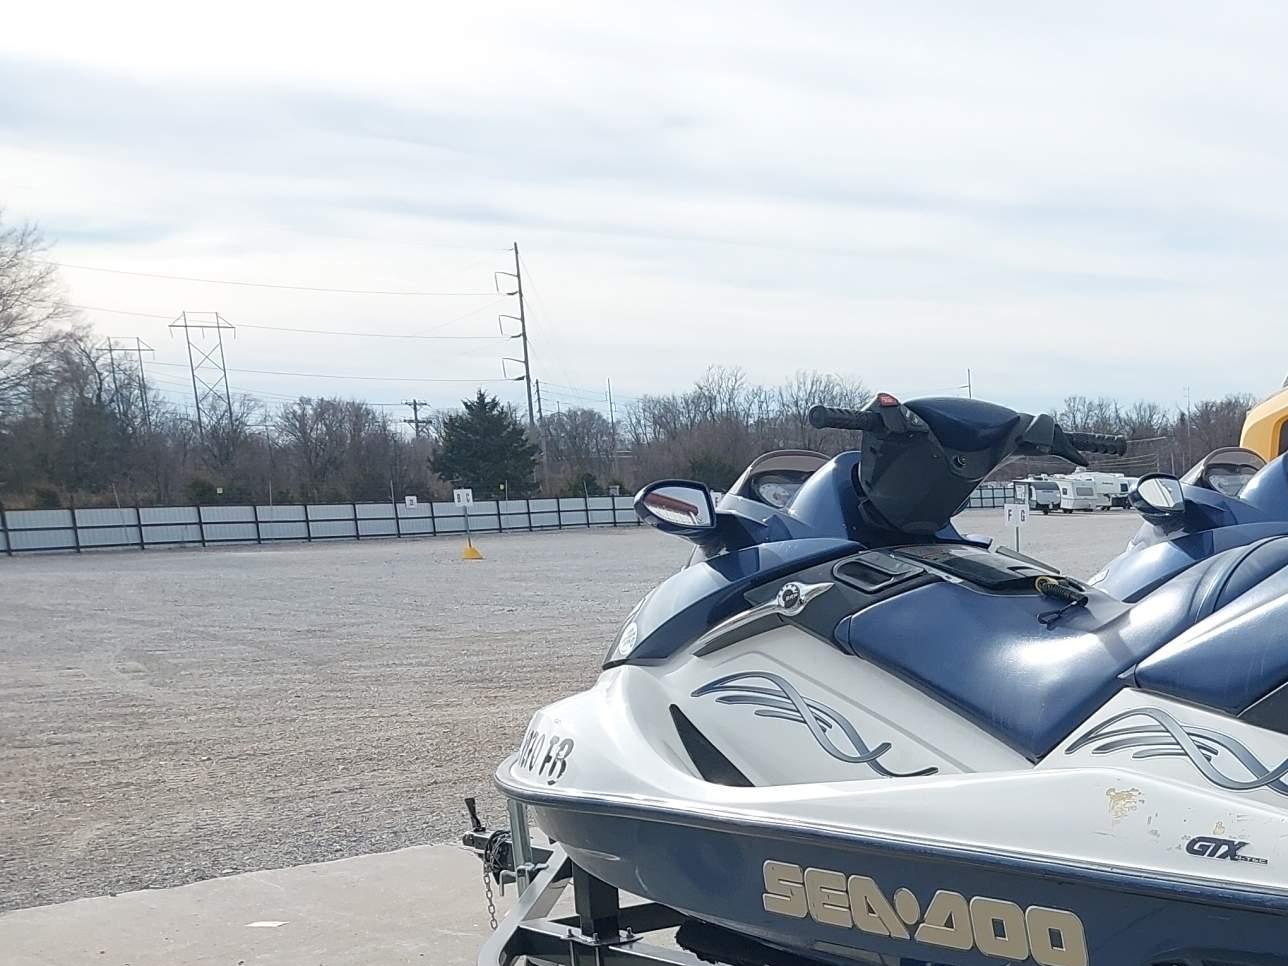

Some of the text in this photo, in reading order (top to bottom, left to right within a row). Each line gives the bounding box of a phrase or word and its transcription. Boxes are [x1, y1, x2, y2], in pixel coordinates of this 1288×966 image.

[1007, 508, 1026, 522] F G
[1185, 836, 1250, 861] GTX
